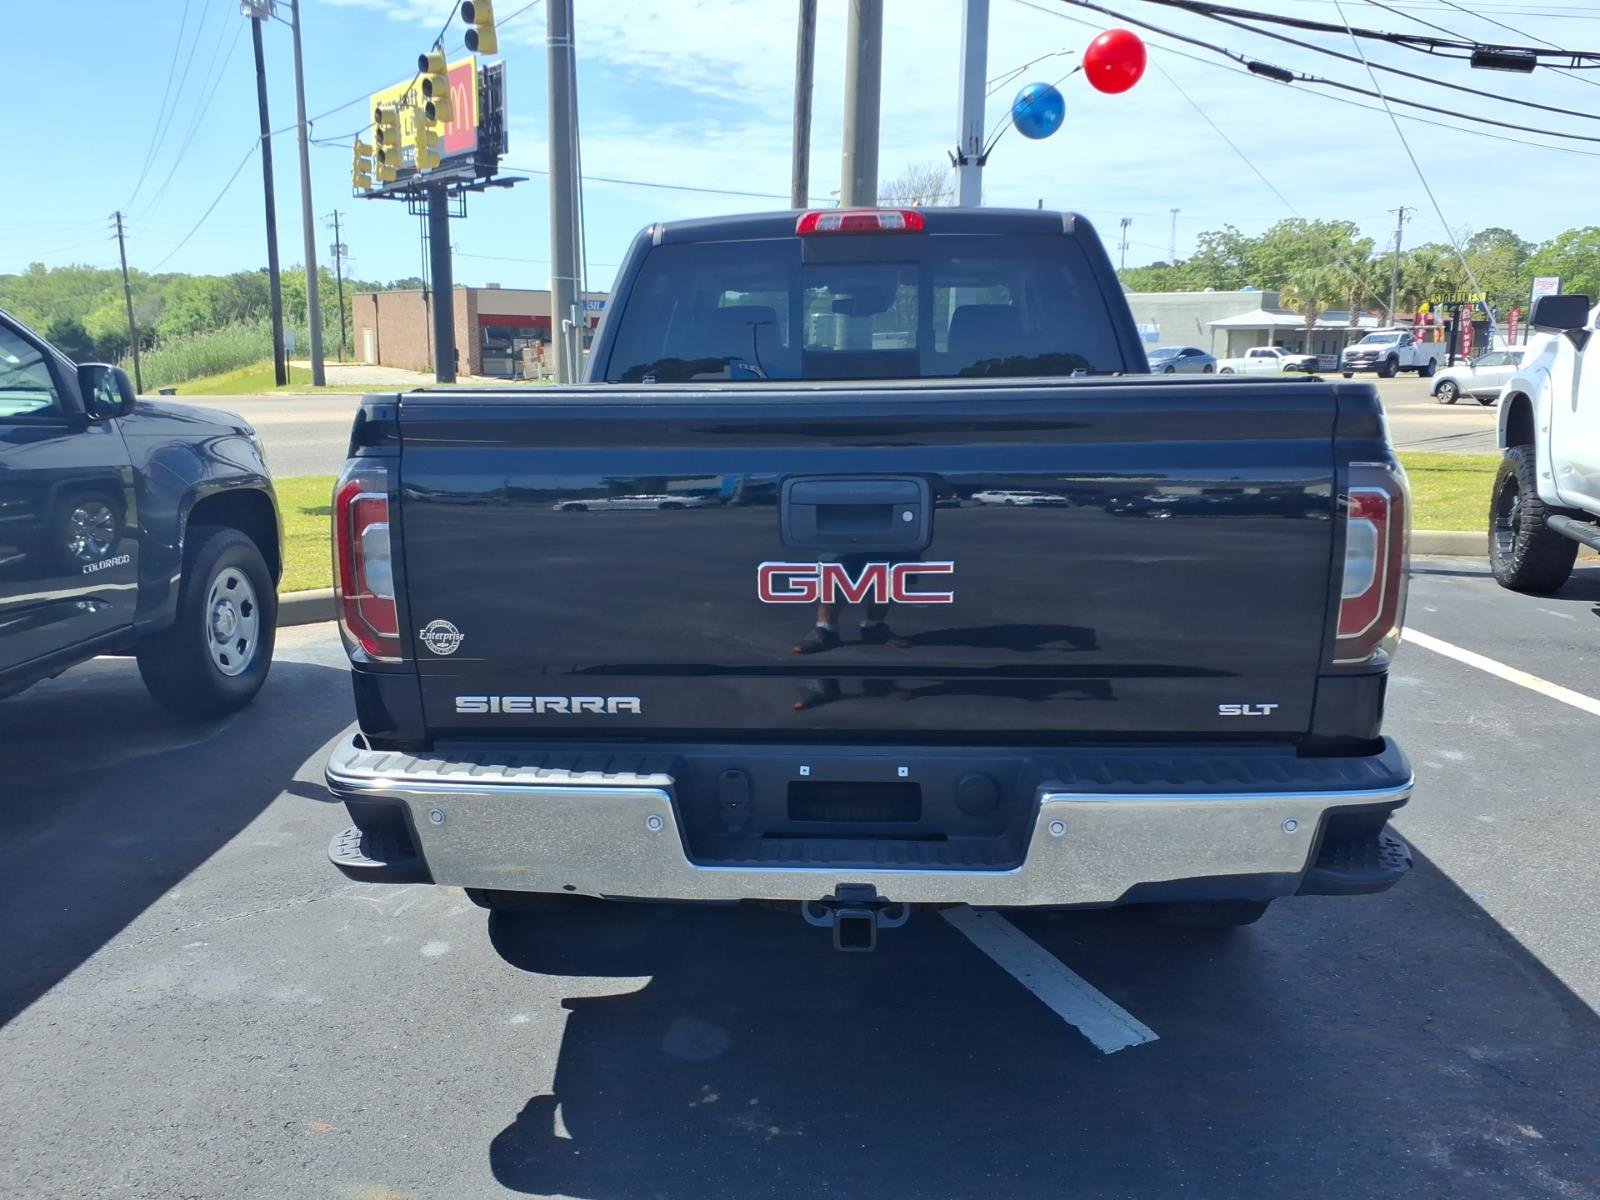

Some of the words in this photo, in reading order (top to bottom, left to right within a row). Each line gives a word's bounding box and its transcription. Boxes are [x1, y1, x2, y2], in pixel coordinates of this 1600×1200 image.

[82, 554, 130, 574] COLORADO
[758, 561, 954, 604] GMC
[419, 629, 465, 643] Enterprise
[455, 696, 642, 714] SIERRA
[1218, 703, 1279, 716] SLT
